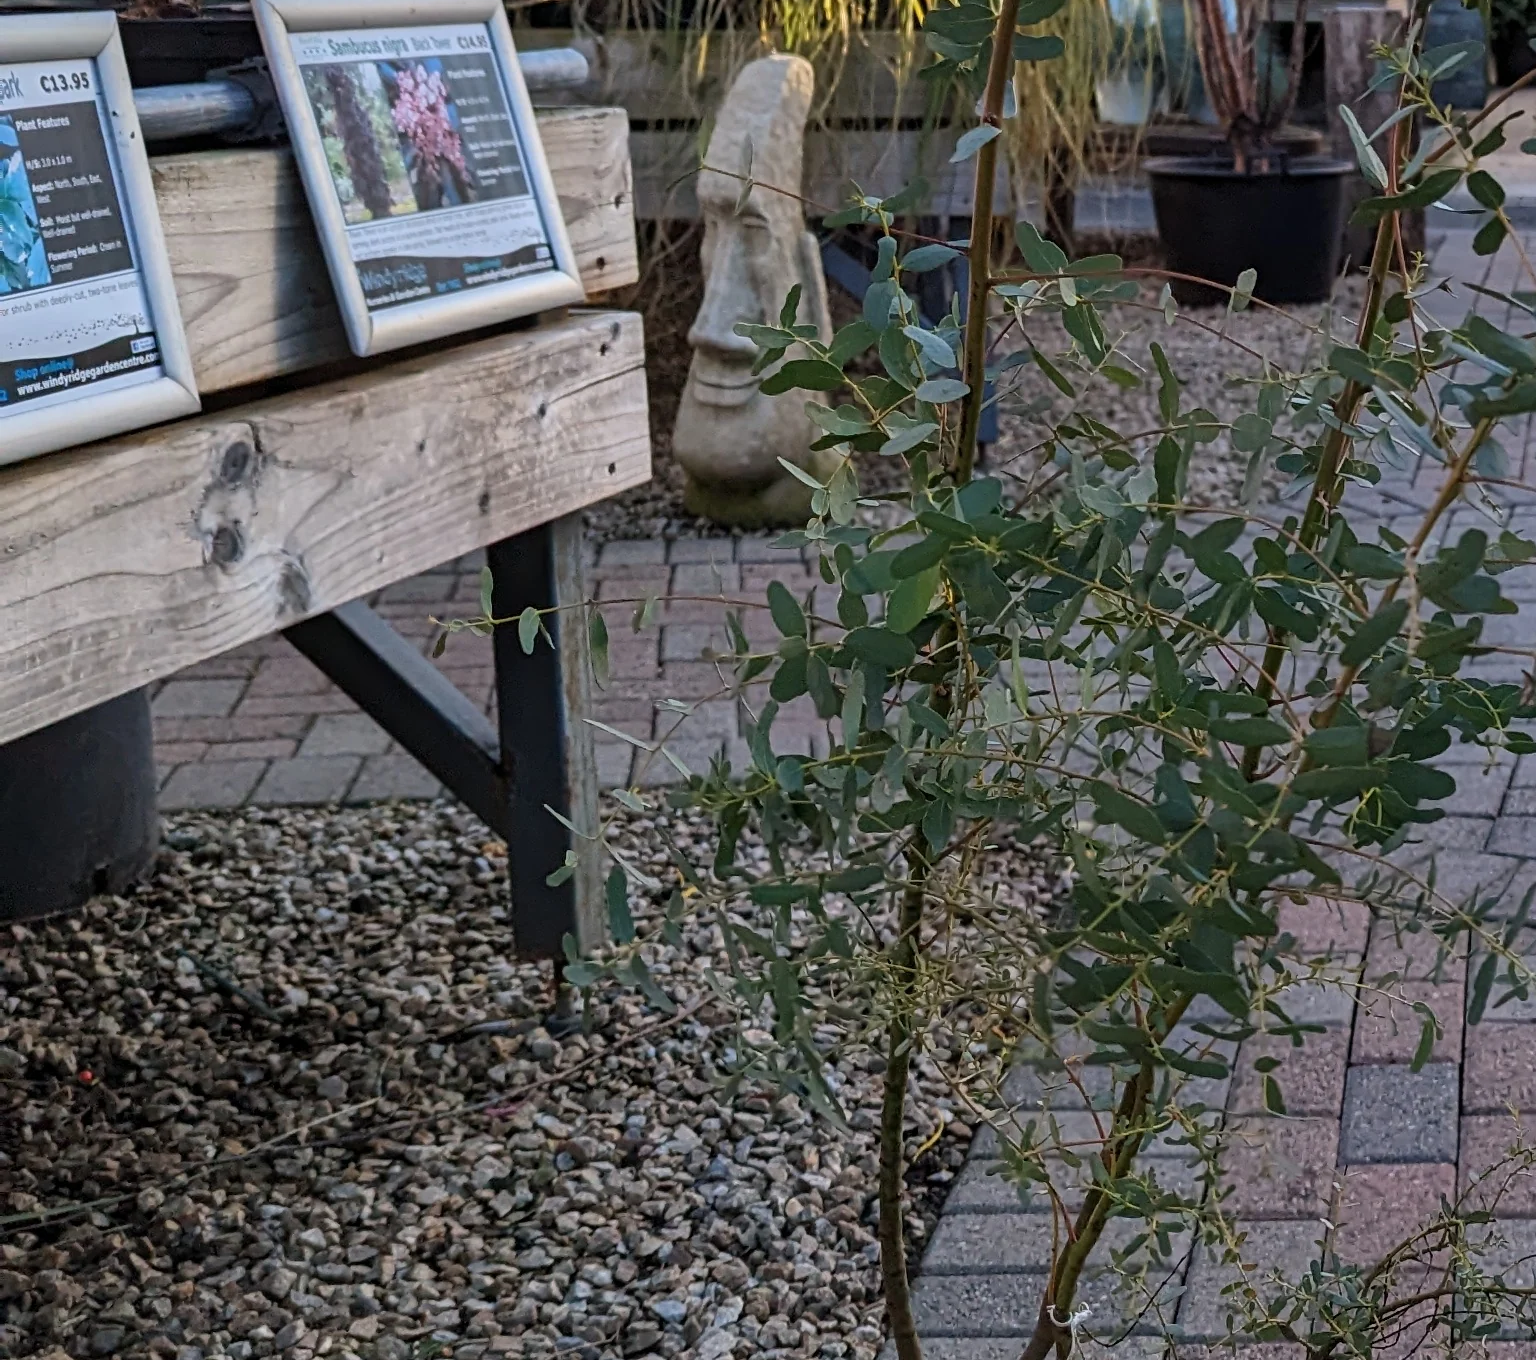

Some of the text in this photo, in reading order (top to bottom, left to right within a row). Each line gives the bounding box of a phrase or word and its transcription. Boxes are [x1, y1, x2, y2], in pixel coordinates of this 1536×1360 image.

[15, 116, 71, 132] Plant Features
[47, 249, 77, 262] Flowering
[50, 262, 73, 274] Summer
[12, 301, 32, 315] shrub
[34, 298, 50, 309] with
[50, 290, 87, 308] deeply-cut,
[88, 285, 117, 299] two-tone
[15, 366, 39, 382] Shop
